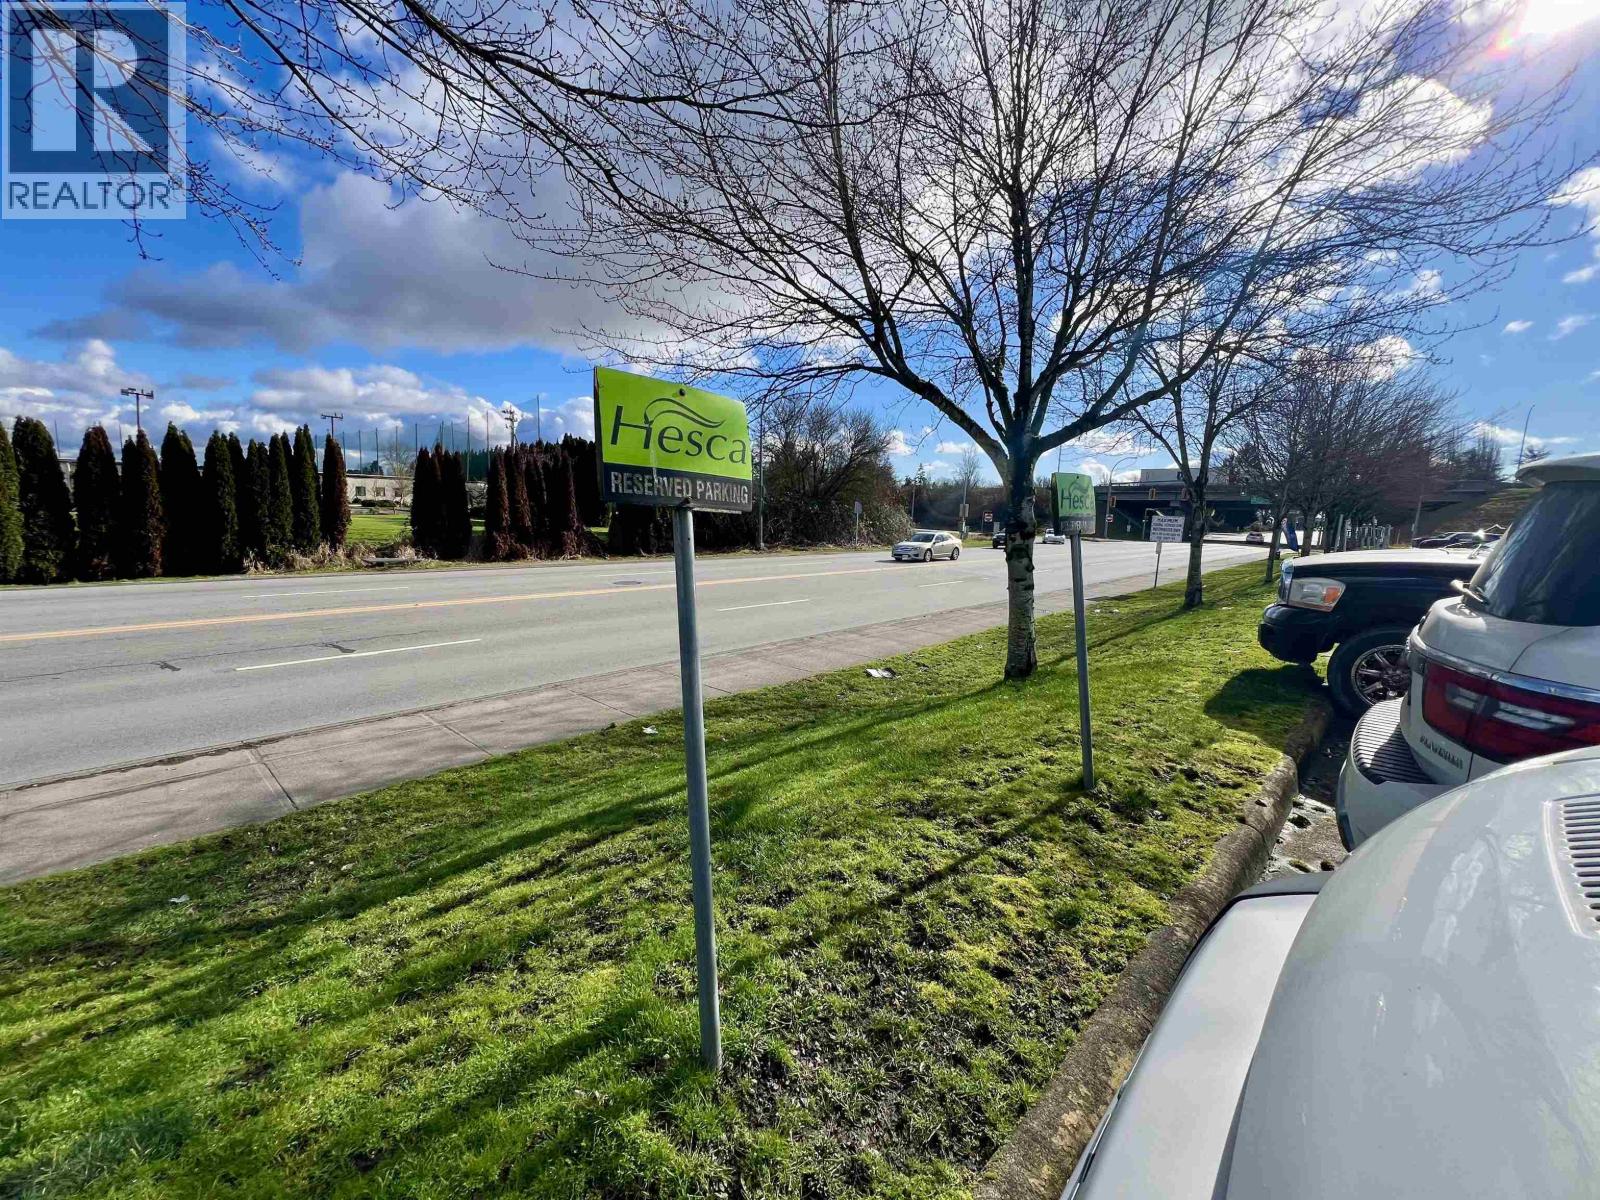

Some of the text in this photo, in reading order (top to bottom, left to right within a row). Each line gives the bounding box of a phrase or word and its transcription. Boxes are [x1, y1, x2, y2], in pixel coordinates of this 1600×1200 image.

[610, 399, 747, 465] Hesca
[610, 471, 749, 504] RESERVED PARKING
